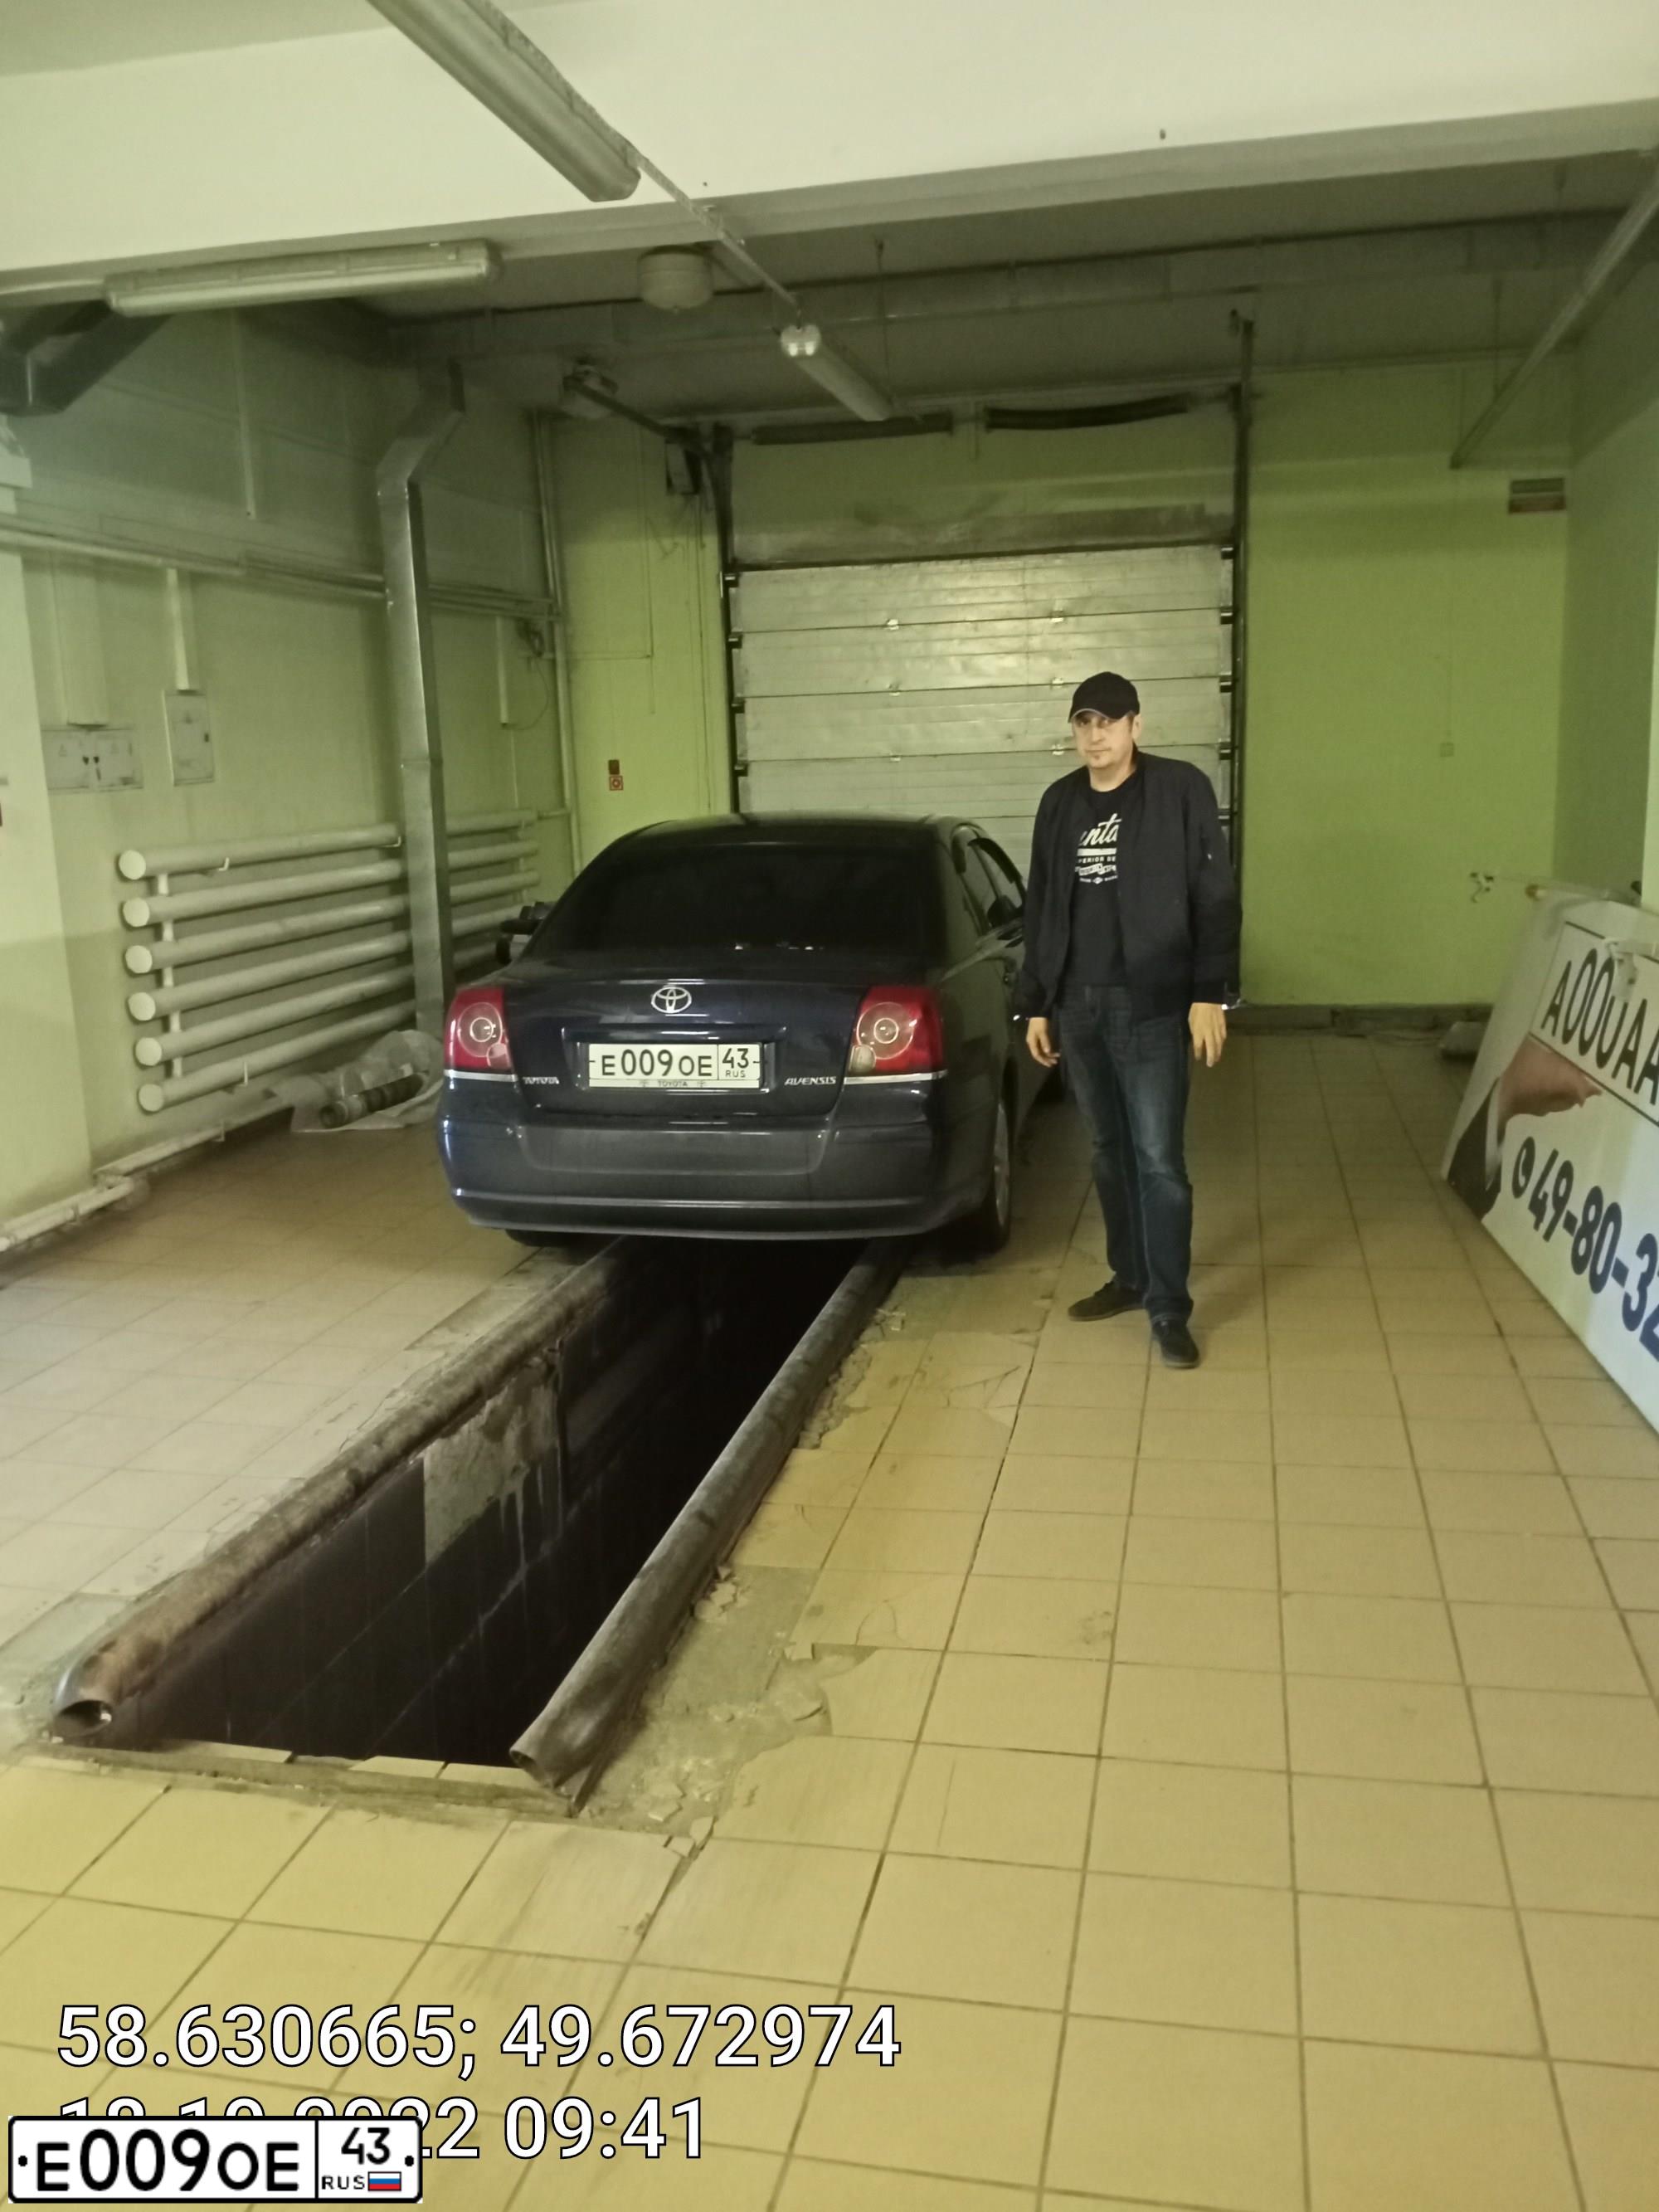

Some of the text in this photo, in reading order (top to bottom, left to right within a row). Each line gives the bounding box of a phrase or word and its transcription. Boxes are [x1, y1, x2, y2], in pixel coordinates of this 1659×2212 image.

[722, 1048, 750, 1069] 43
[725, 1069, 746, 1078] RUS
[784, 1076, 837, 1085] AVENSIS
